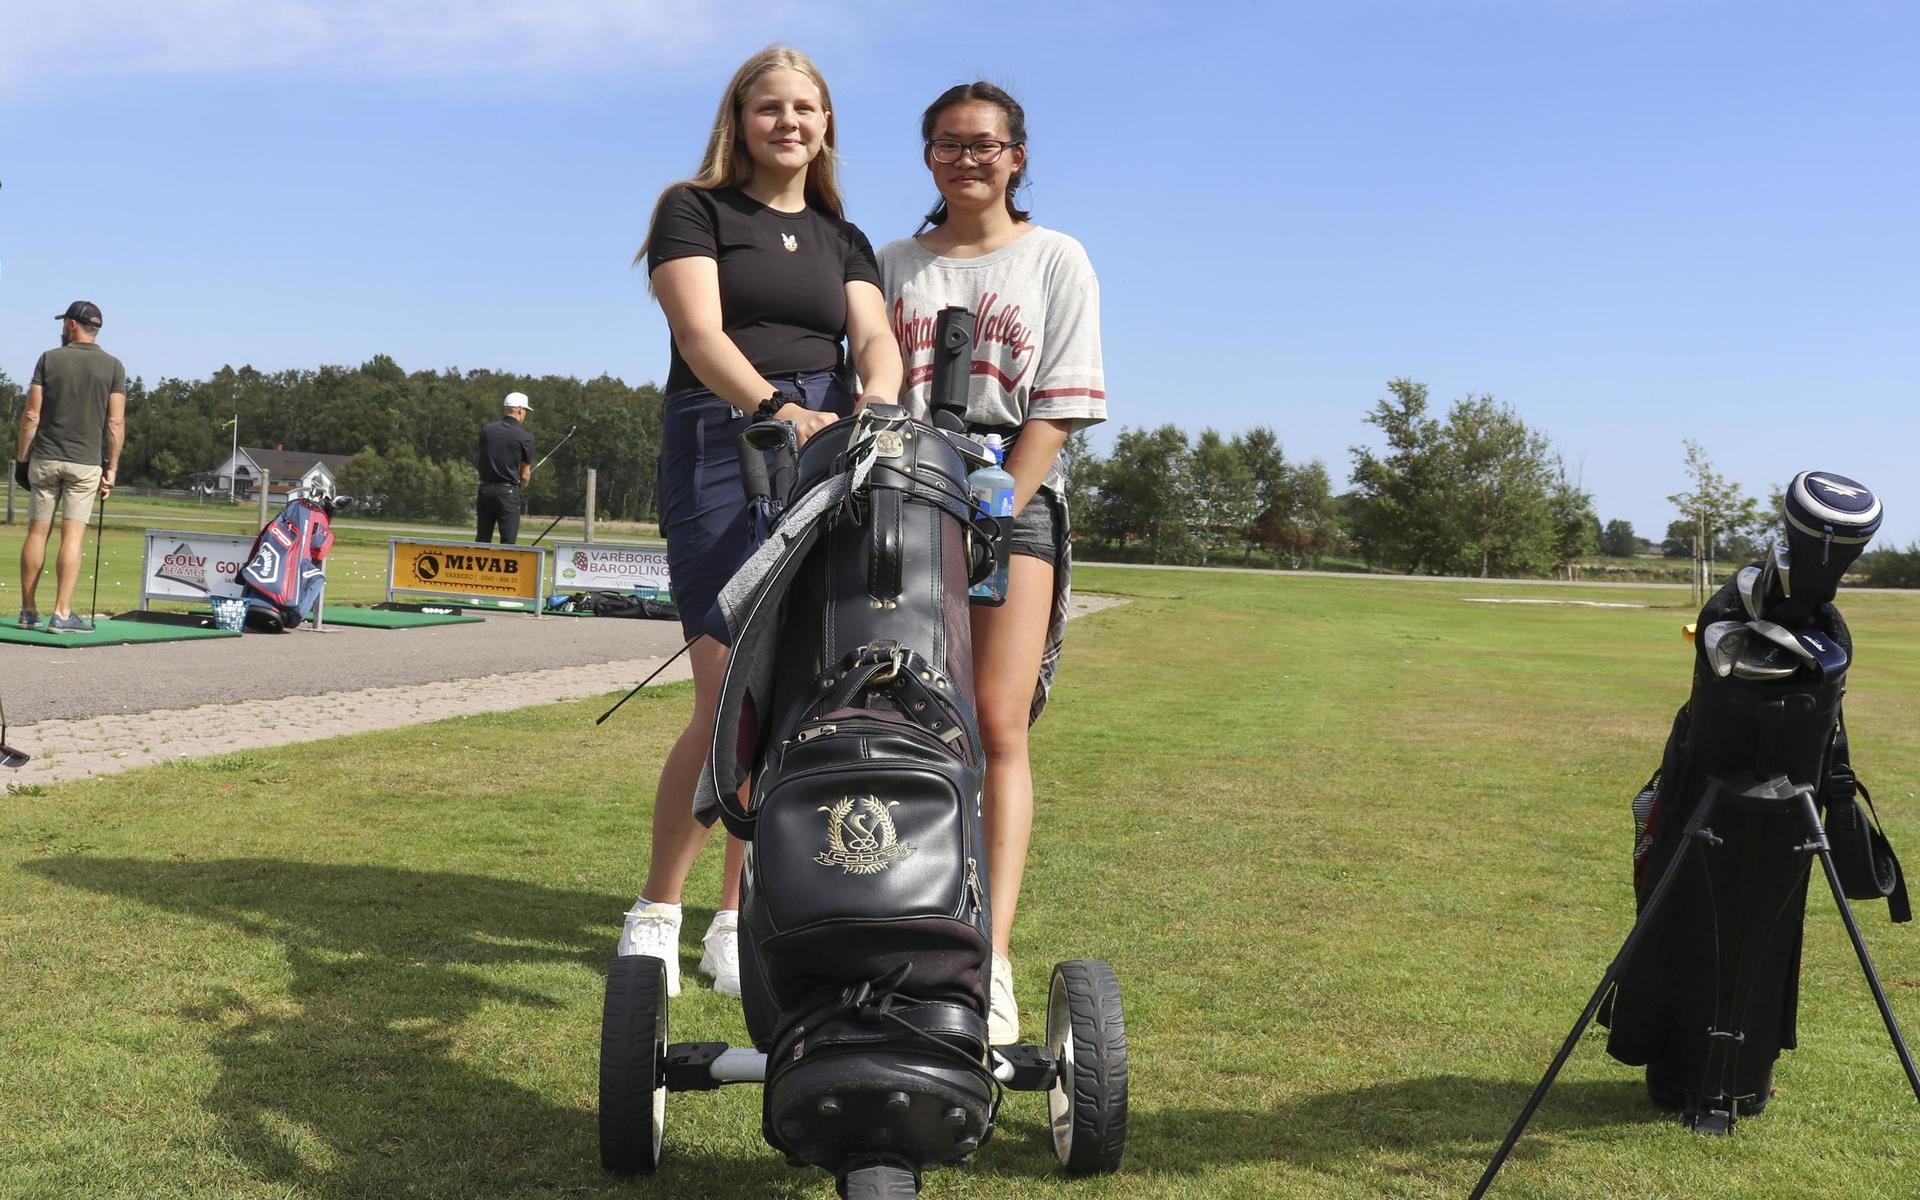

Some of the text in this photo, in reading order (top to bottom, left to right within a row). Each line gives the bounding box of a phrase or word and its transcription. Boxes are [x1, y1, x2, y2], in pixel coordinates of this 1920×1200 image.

[972, 292, 1034, 359] Valley
[164, 554, 207, 567] GOLV
[163, 567, 207, 577] TEAMET
[833, 848, 899, 863] cobra
